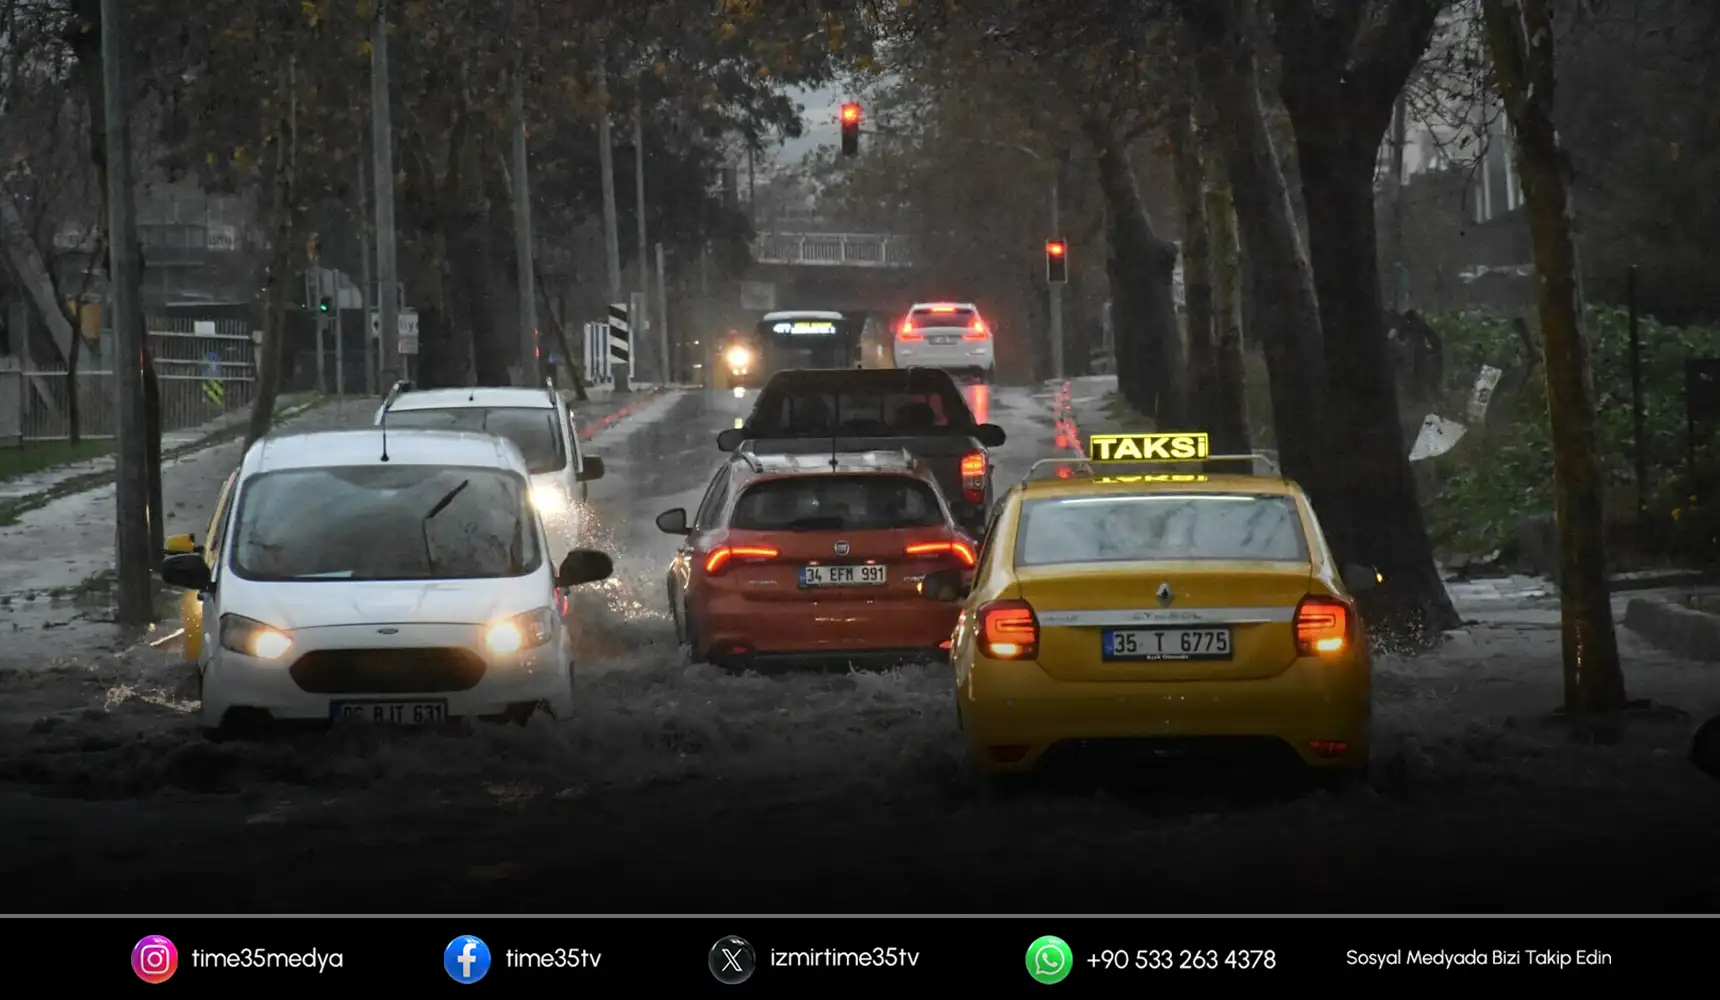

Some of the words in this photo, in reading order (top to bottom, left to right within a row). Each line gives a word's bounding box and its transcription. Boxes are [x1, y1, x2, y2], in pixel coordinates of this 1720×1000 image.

[806, 568, 822, 583] 34
[829, 566, 854, 581] EFM
[861, 566, 884, 581] 991
[1113, 633, 1138, 653] 35
[1154, 632, 1165, 652] T
[1180, 631, 1228, 653] 6775
